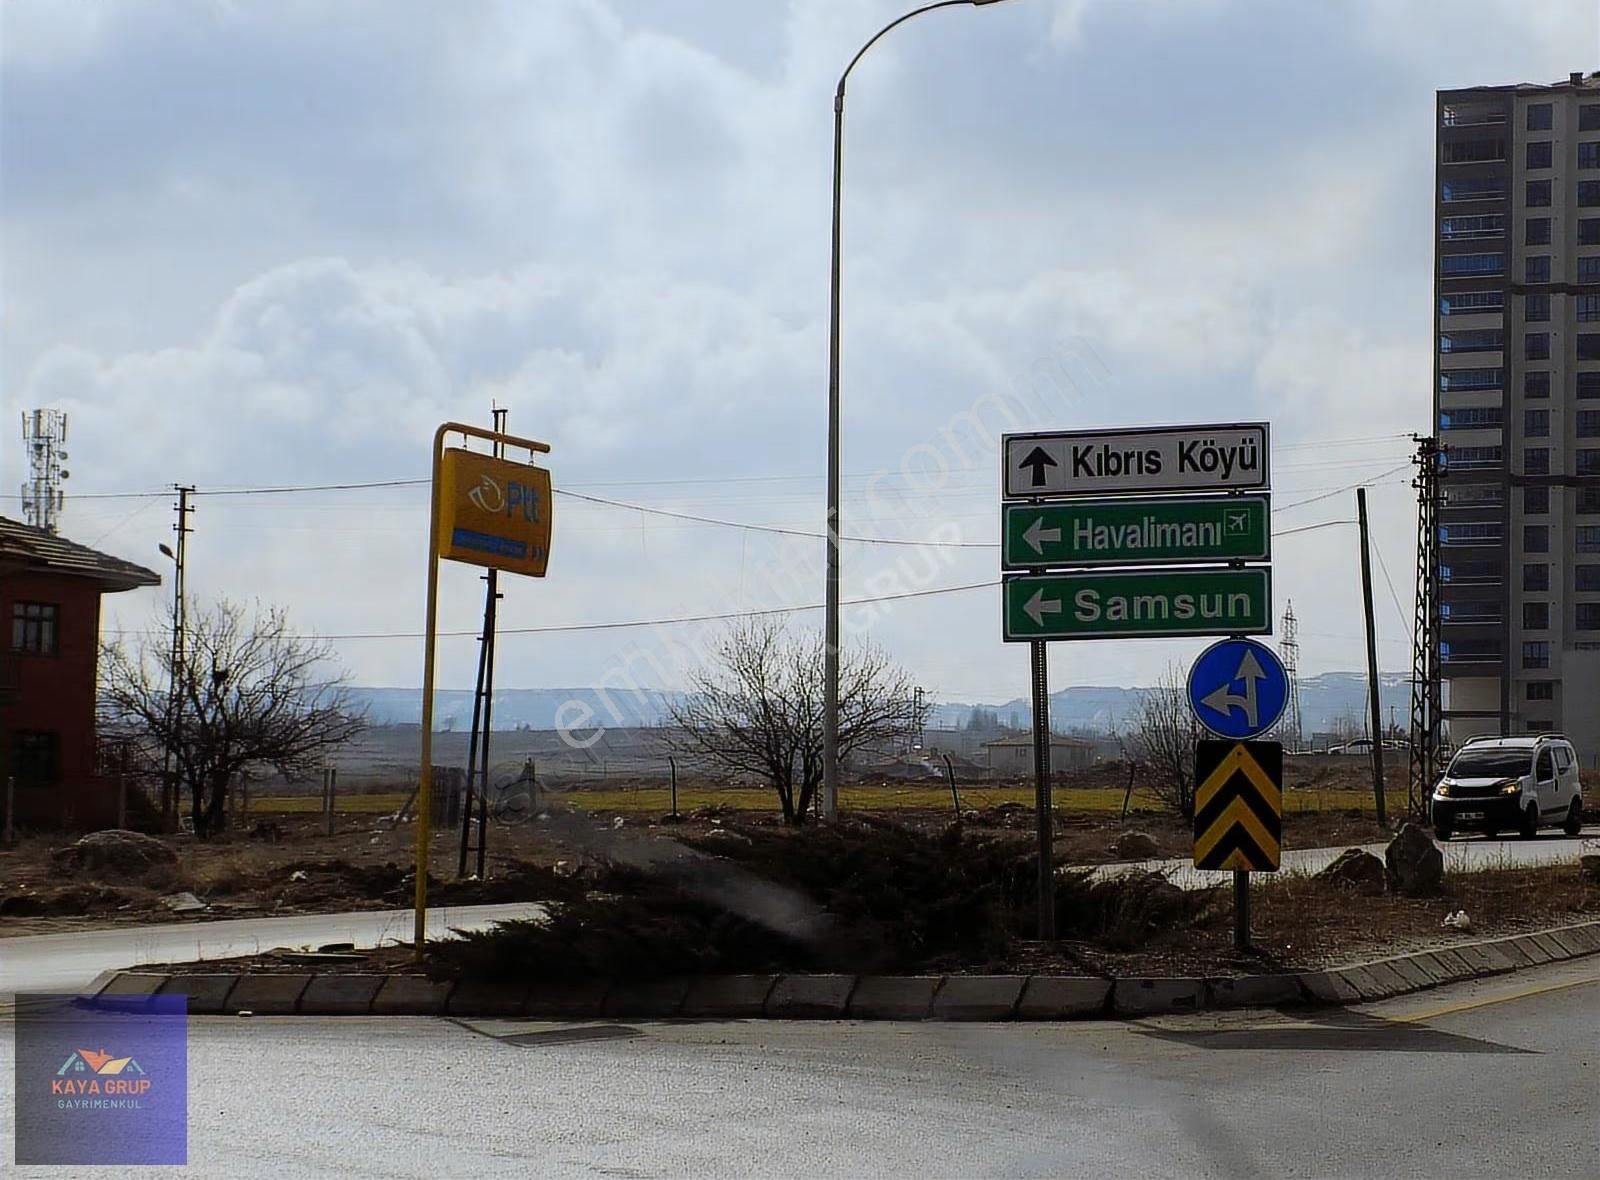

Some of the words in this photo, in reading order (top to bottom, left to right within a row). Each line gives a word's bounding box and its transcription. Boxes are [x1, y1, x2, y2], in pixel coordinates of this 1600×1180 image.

[1072, 444, 1162, 478] Kıbrıs
[1177, 437, 1258, 480] Köyü
[1073, 516, 1222, 550] Havalimanı
[1074, 588, 1251, 622] Samsun
